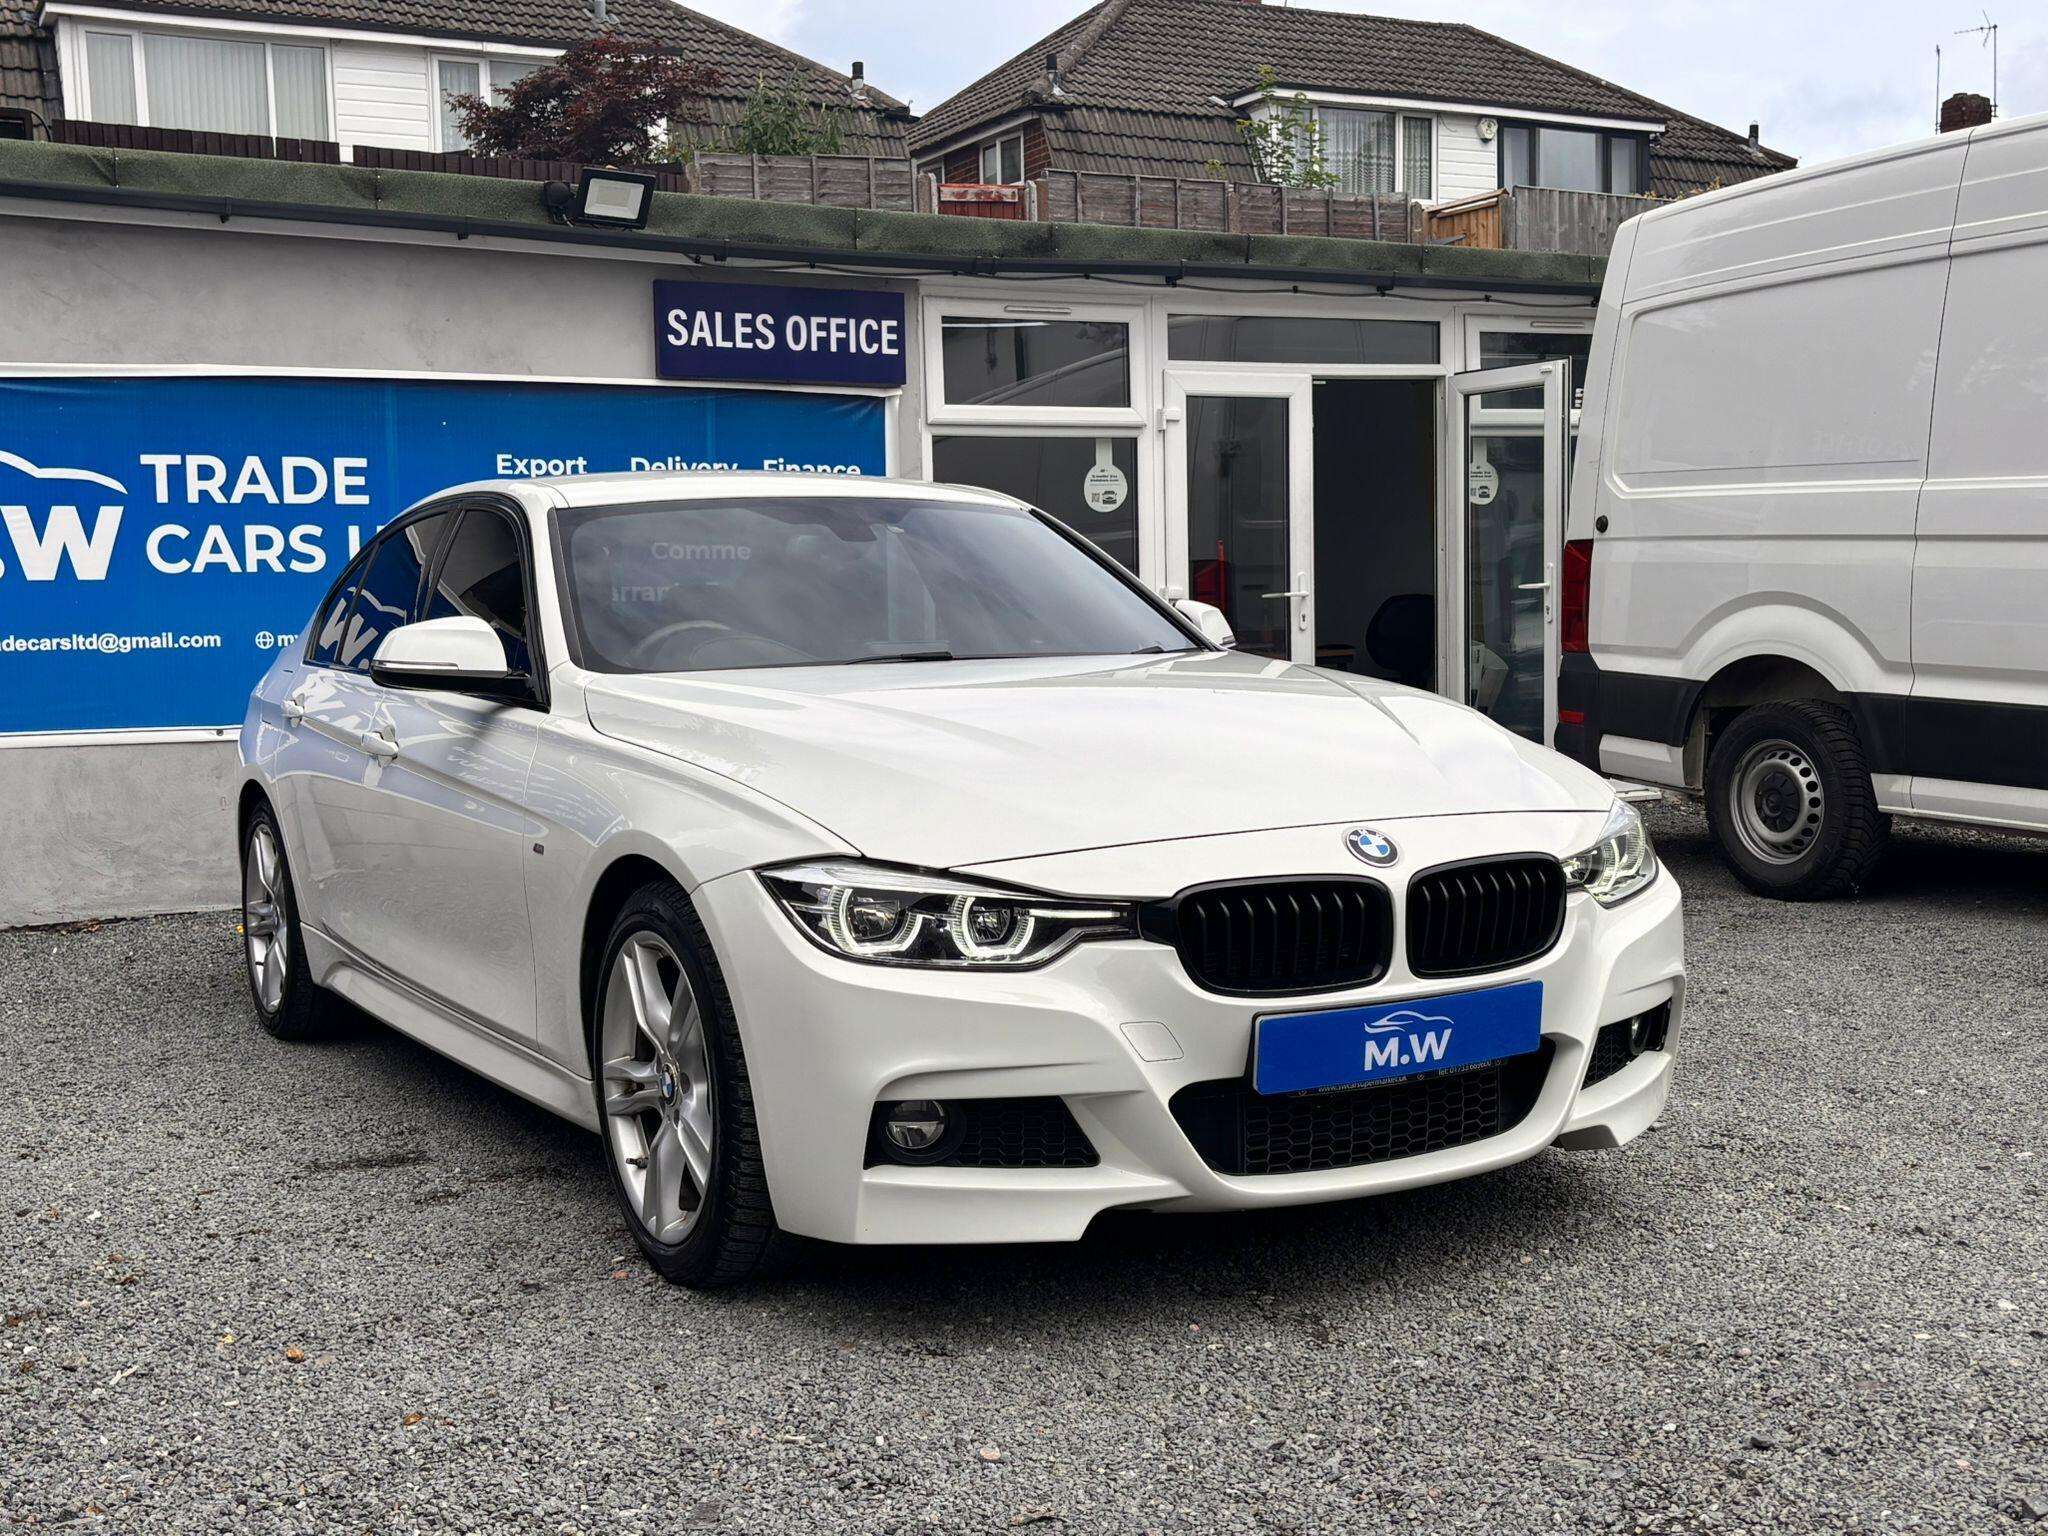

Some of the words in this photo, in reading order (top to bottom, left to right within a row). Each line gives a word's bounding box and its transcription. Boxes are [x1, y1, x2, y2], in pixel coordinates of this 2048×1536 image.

[667, 308, 776, 351] SALES
[785, 314, 900, 357] OFFICE
[139, 453, 370, 506] TRADE
[496, 453, 588, 478] Export
[145, 524, 327, 575] CARS
[0, 632, 222, 654] decarsltd@gmail.com
[1364, 1028, 1452, 1071] M.W
